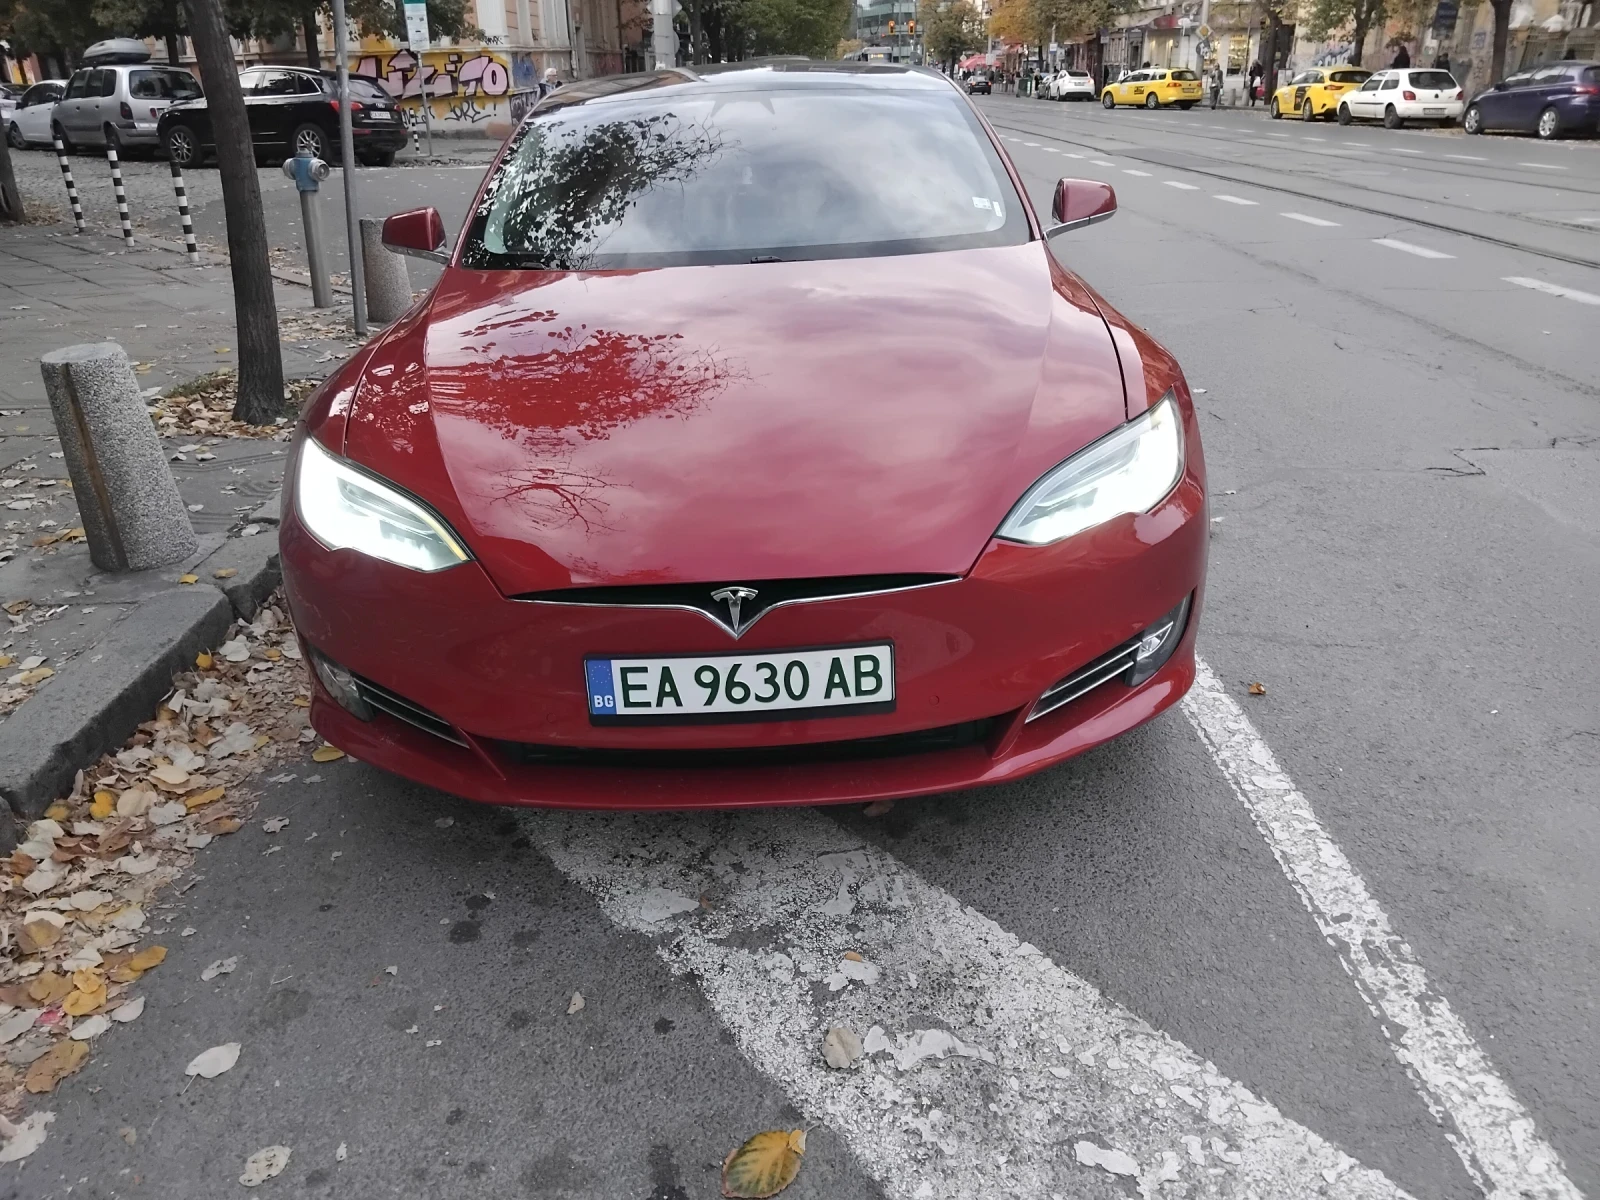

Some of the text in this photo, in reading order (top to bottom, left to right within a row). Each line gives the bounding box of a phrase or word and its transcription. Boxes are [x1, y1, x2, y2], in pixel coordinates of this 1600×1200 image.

[620, 654, 883, 708] EA 9630 AB
[593, 695, 614, 708] BG
